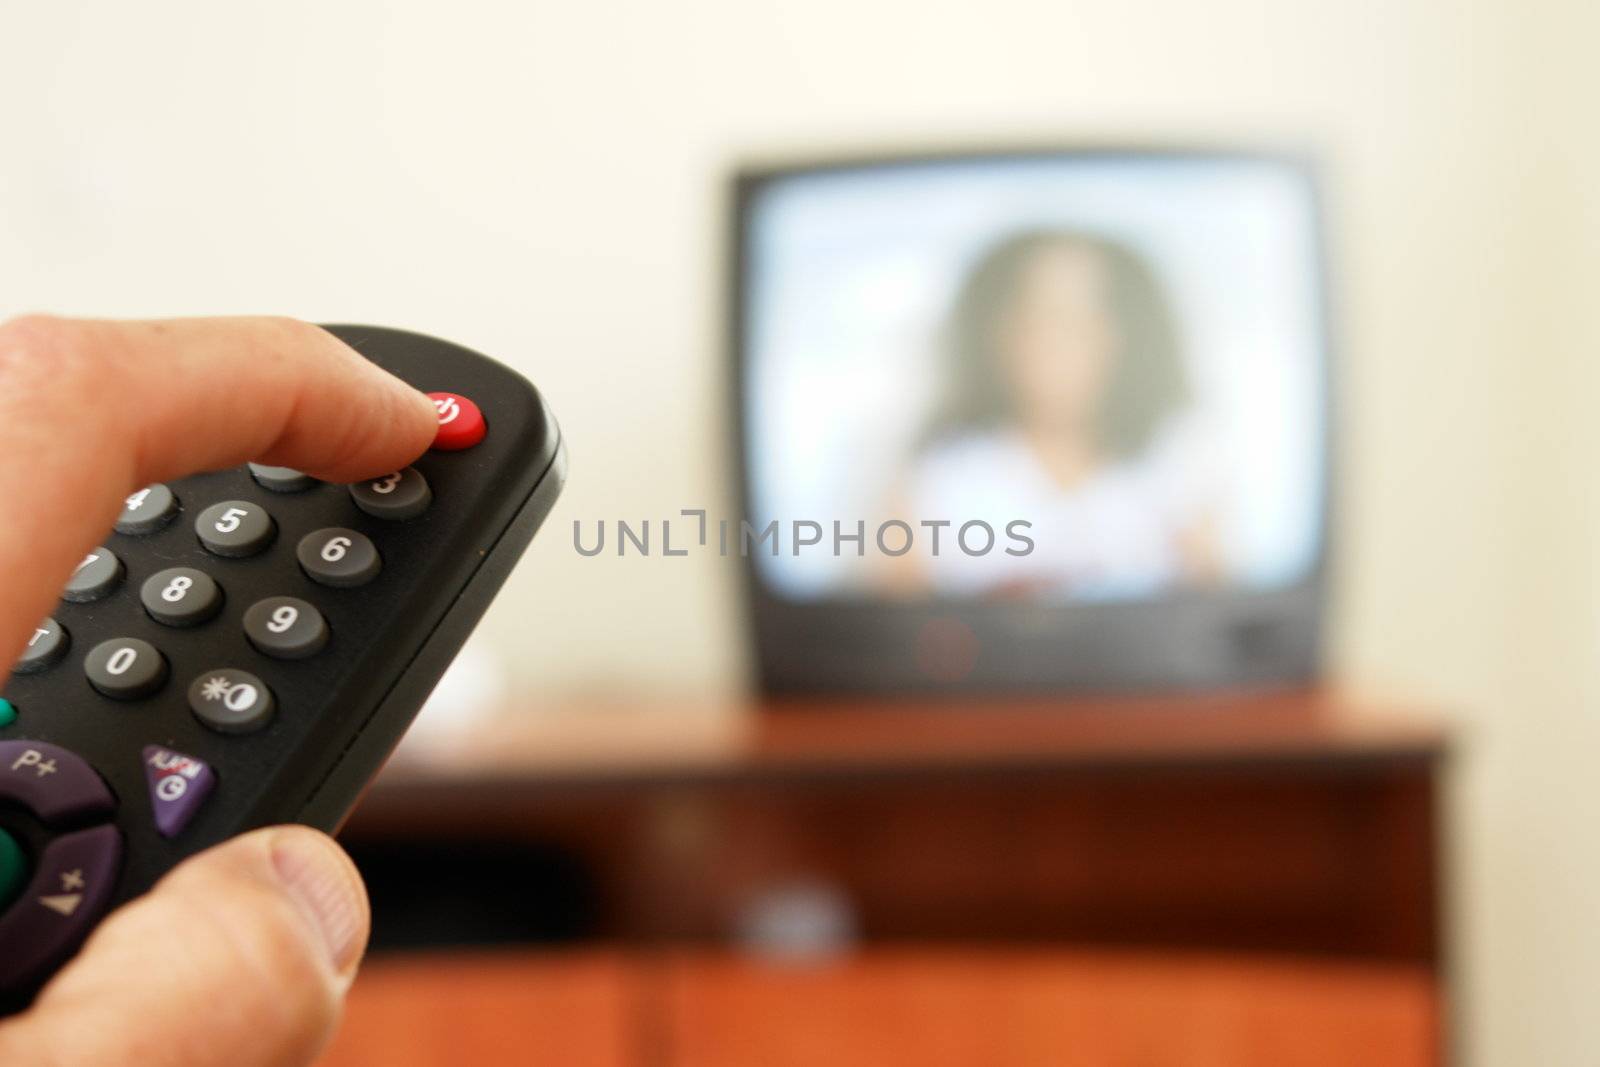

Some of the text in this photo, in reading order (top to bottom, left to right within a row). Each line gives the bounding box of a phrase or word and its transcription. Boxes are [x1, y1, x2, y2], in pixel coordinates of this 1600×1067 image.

[372, 471, 402, 494] 3
[126, 488, 152, 511] 4
[214, 508, 248, 533] 5
[321, 536, 352, 562] 6
[162, 576, 192, 602] 8
[267, 606, 298, 633] 9
[12, 750, 57, 777] P+
